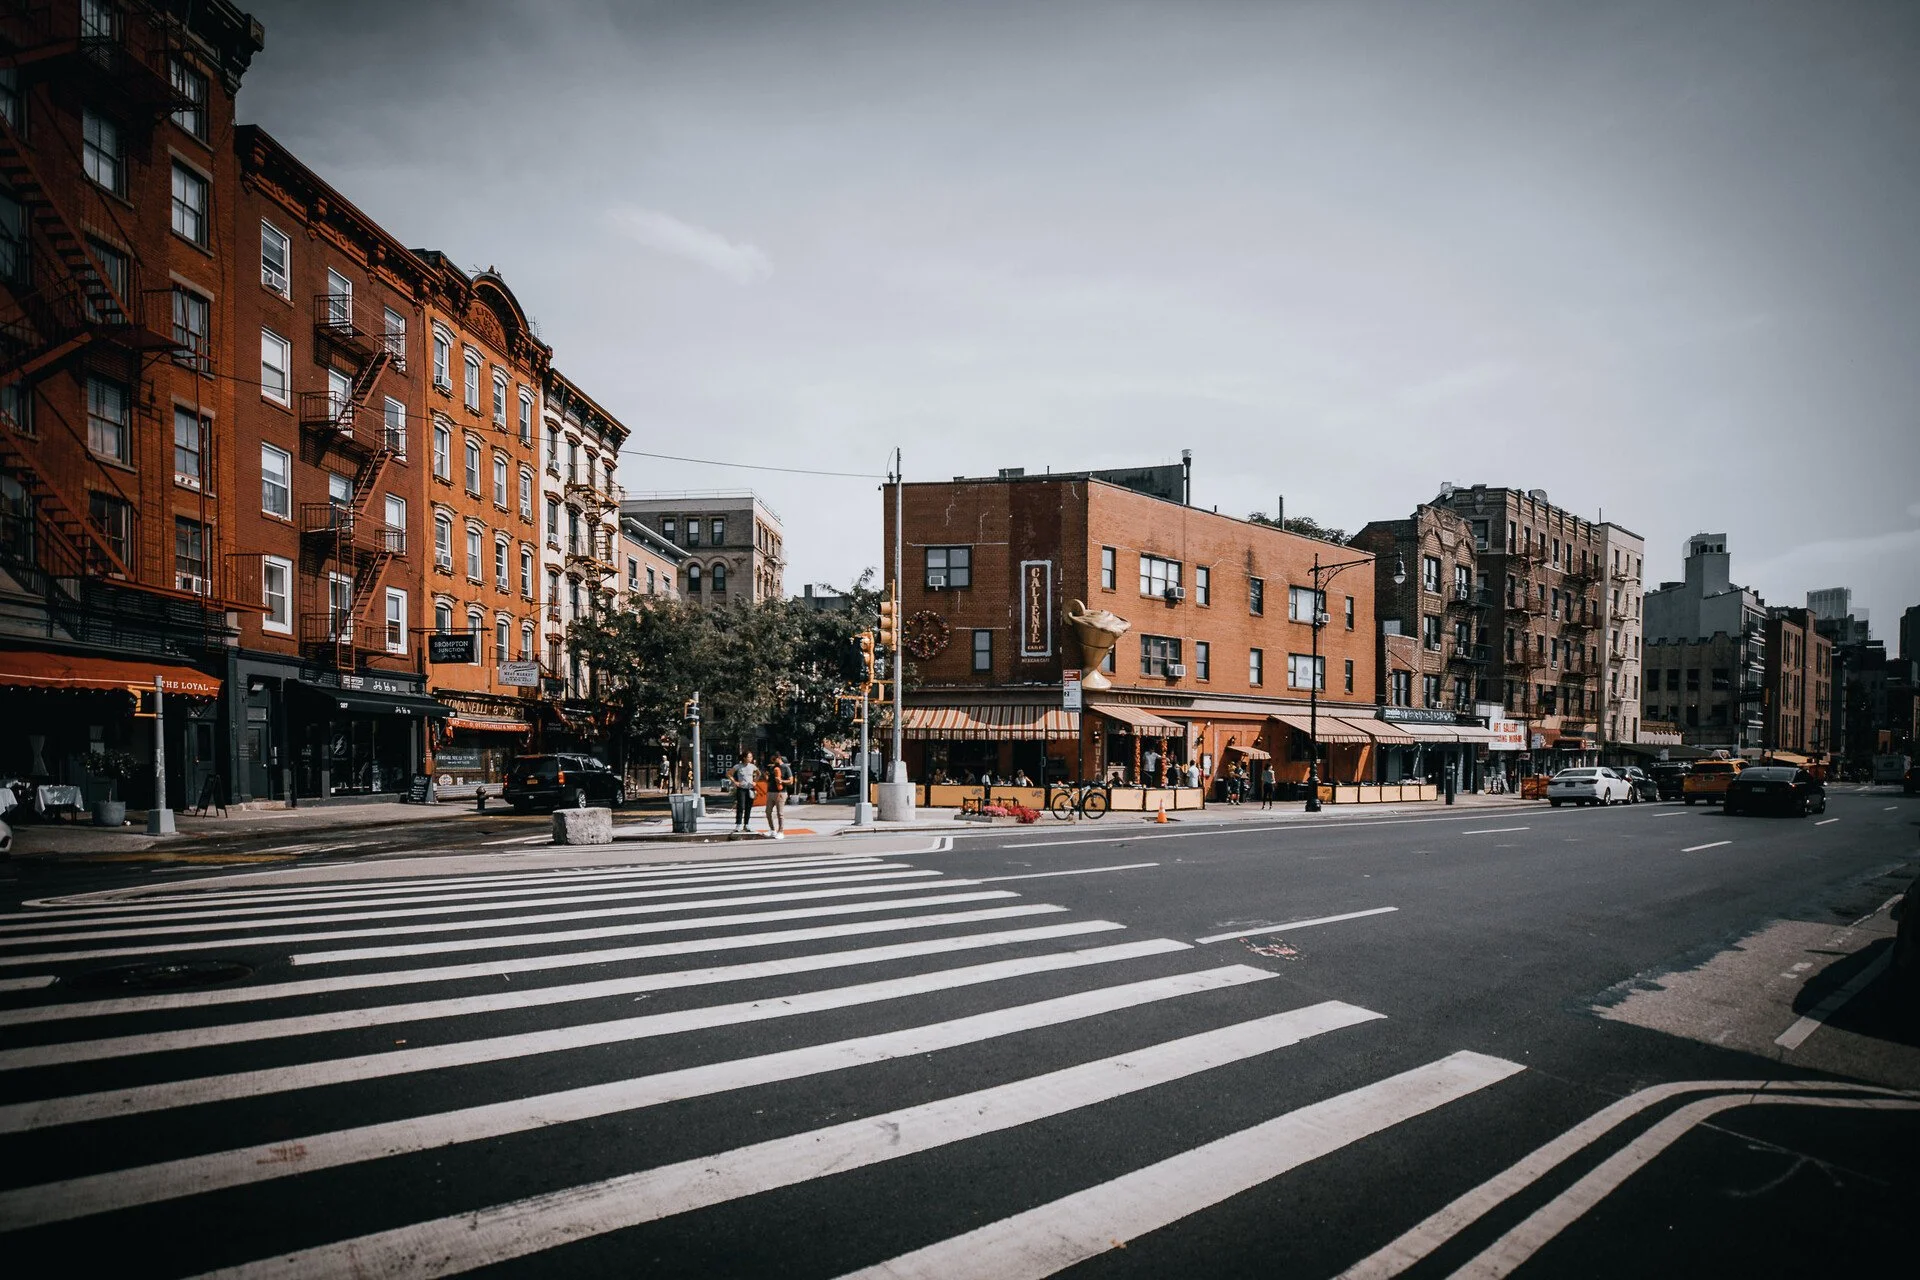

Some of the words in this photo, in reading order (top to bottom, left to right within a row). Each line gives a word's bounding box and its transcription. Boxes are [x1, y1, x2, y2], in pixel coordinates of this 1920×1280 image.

[1031, 567, 1040, 643] CALIENTE
[161, 680, 179, 689] THE
[181, 682, 209, 691] LOYAL
[442, 698, 488, 714] TOMANELLI
